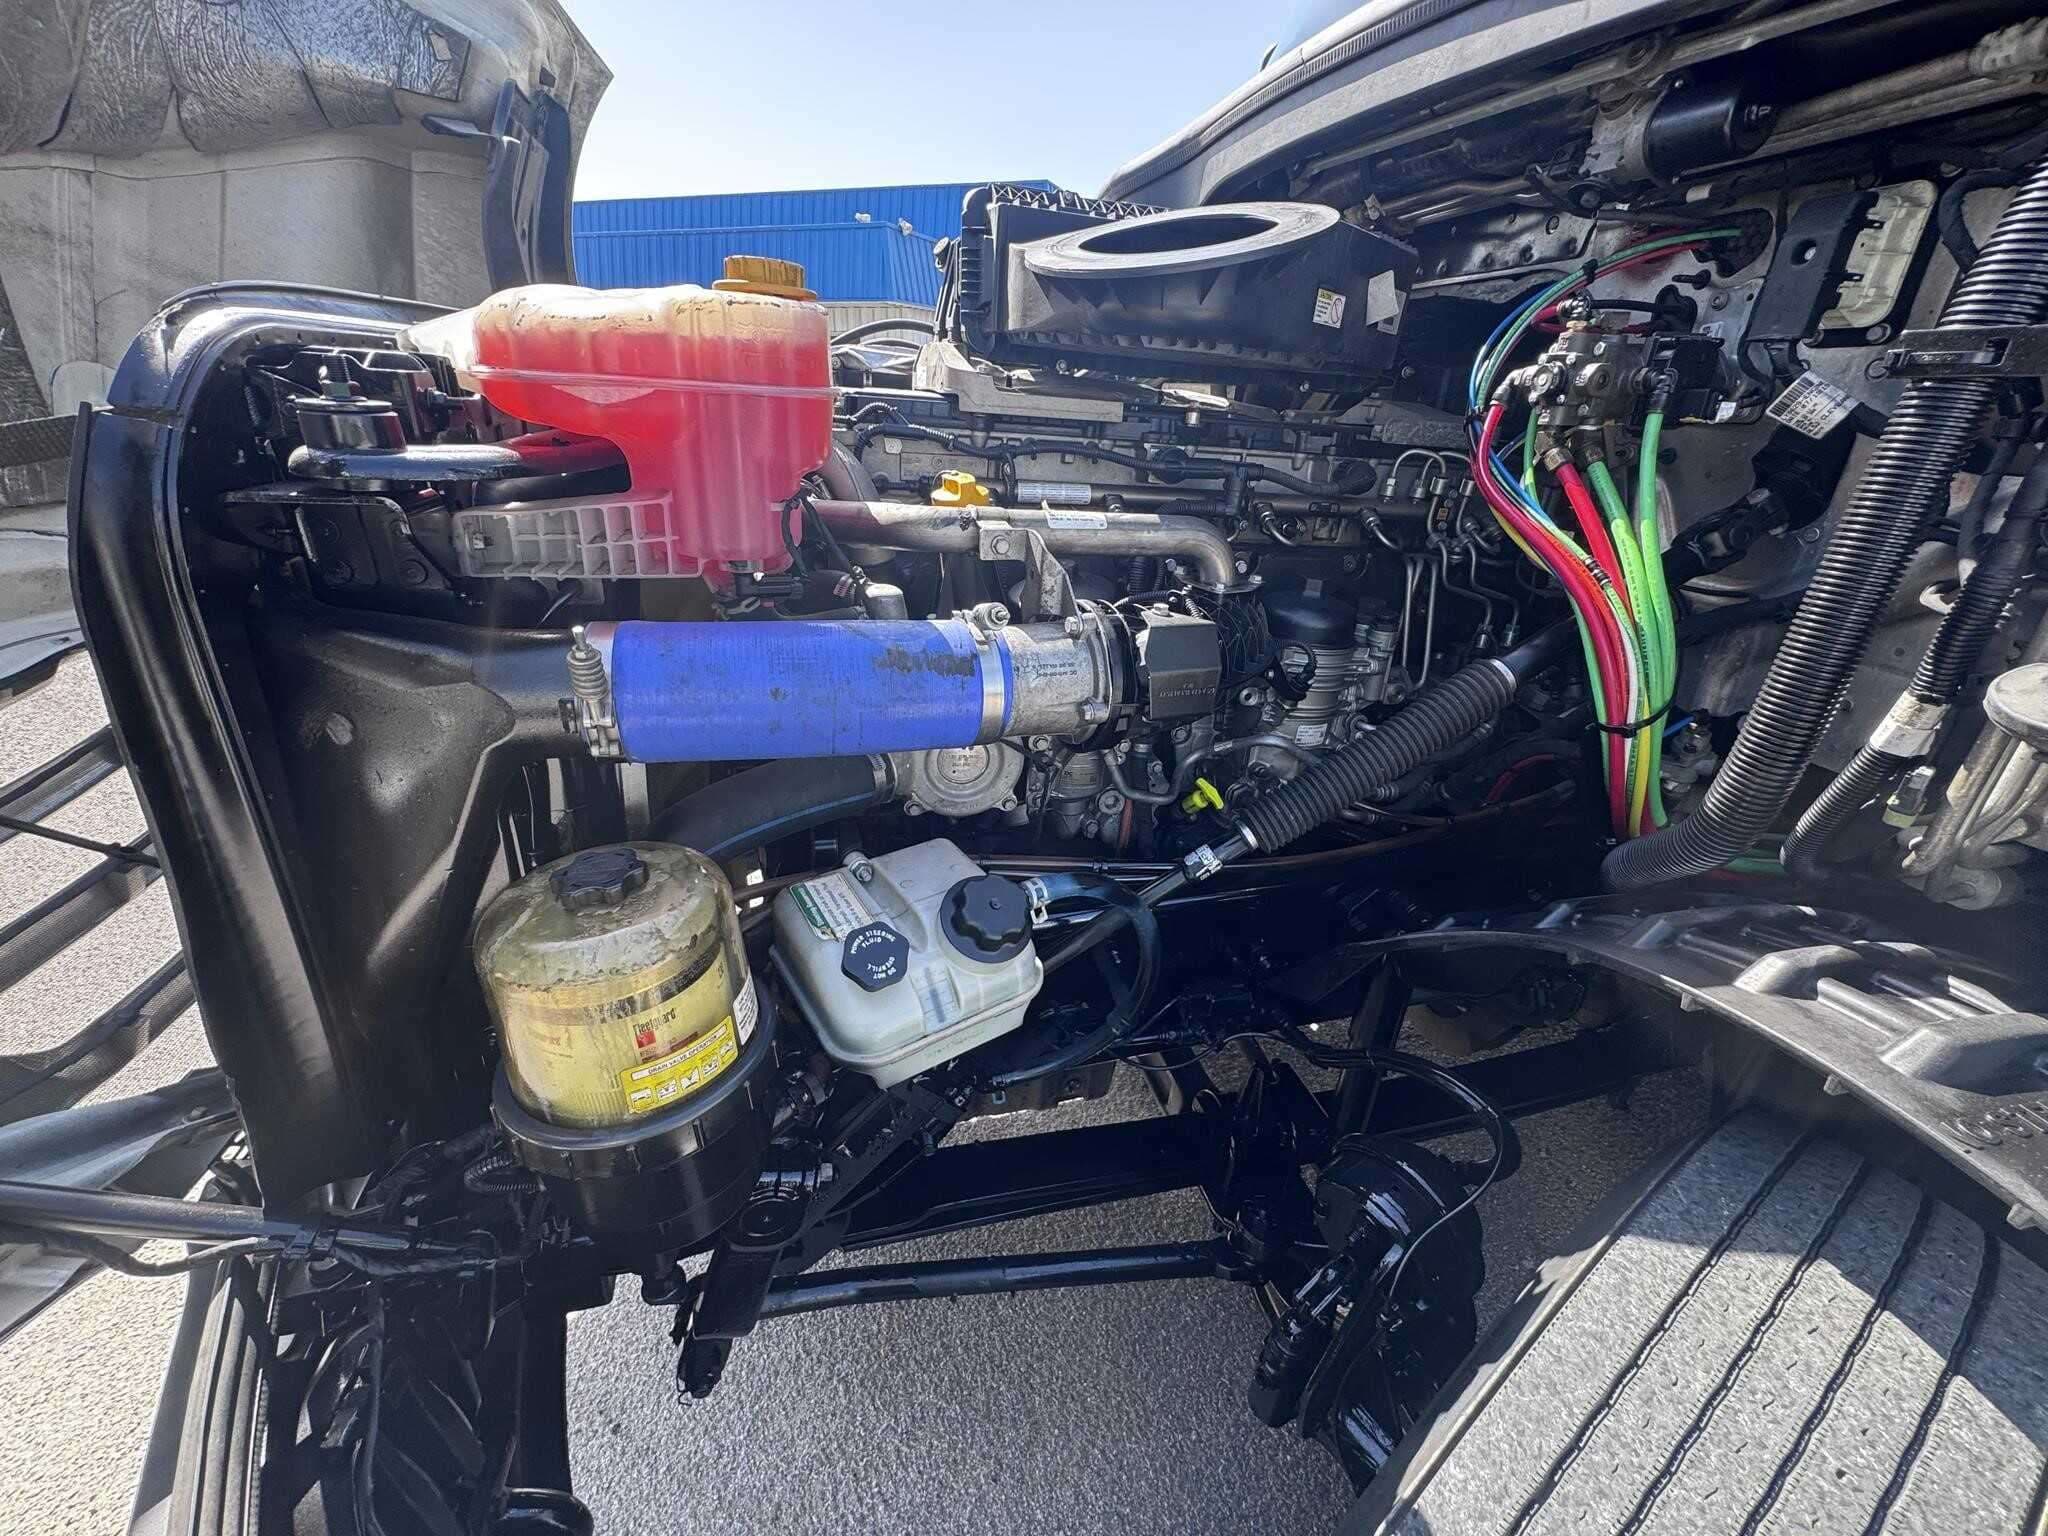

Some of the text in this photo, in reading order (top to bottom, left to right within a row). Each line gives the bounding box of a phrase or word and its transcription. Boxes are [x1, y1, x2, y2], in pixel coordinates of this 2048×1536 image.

[850, 930, 896, 954] POWER STEERING
[861, 936, 882, 948] FLUID
[867, 956, 895, 972] OVERFILL
[633, 1007, 677, 1035] Fleetguard
[648, 1063, 668, 1075] DRAIN
